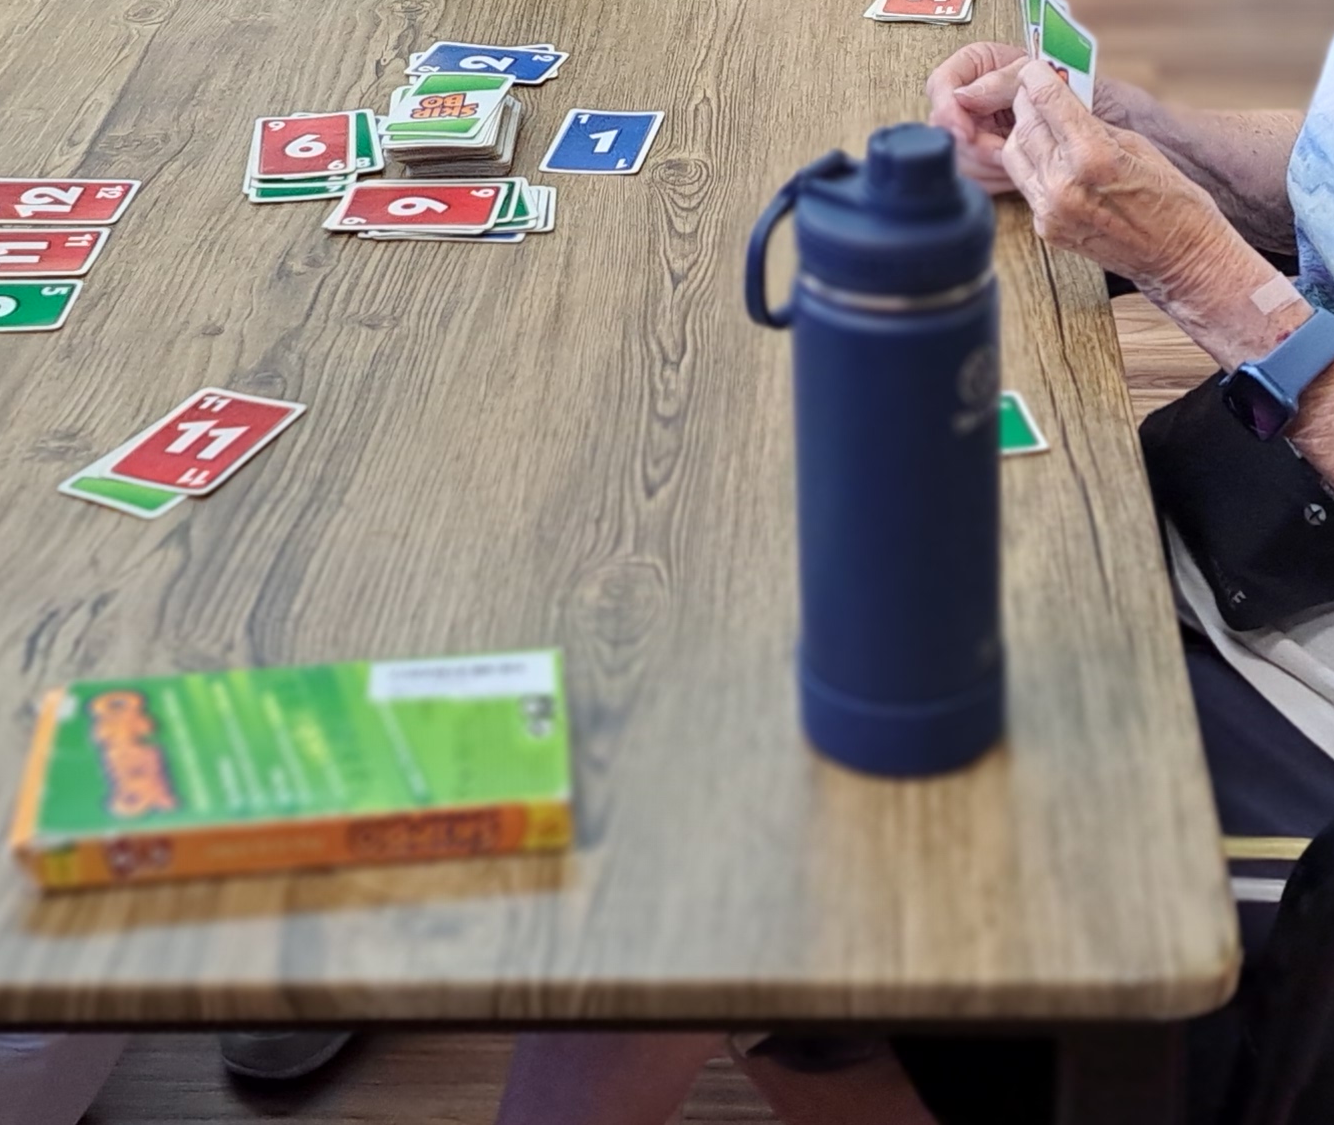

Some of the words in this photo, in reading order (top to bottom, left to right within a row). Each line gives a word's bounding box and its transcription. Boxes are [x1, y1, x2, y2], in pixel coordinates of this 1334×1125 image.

[459, 55, 516, 72] 2
[532, 54, 555, 63] 2
[418, 65, 440, 73] 2
[419, 93, 467, 108] BO
[577, 114, 591, 124] 1
[589, 129, 619, 153] 1
[95, 185, 126, 199] 12
[13, 186, 85, 218] 12
[64, 234, 94, 247] 11
[40, 286, 72, 297] 5
[199, 395, 233, 412] 11
[164, 418, 252, 460] 11
[175, 467, 211, 487] 11
